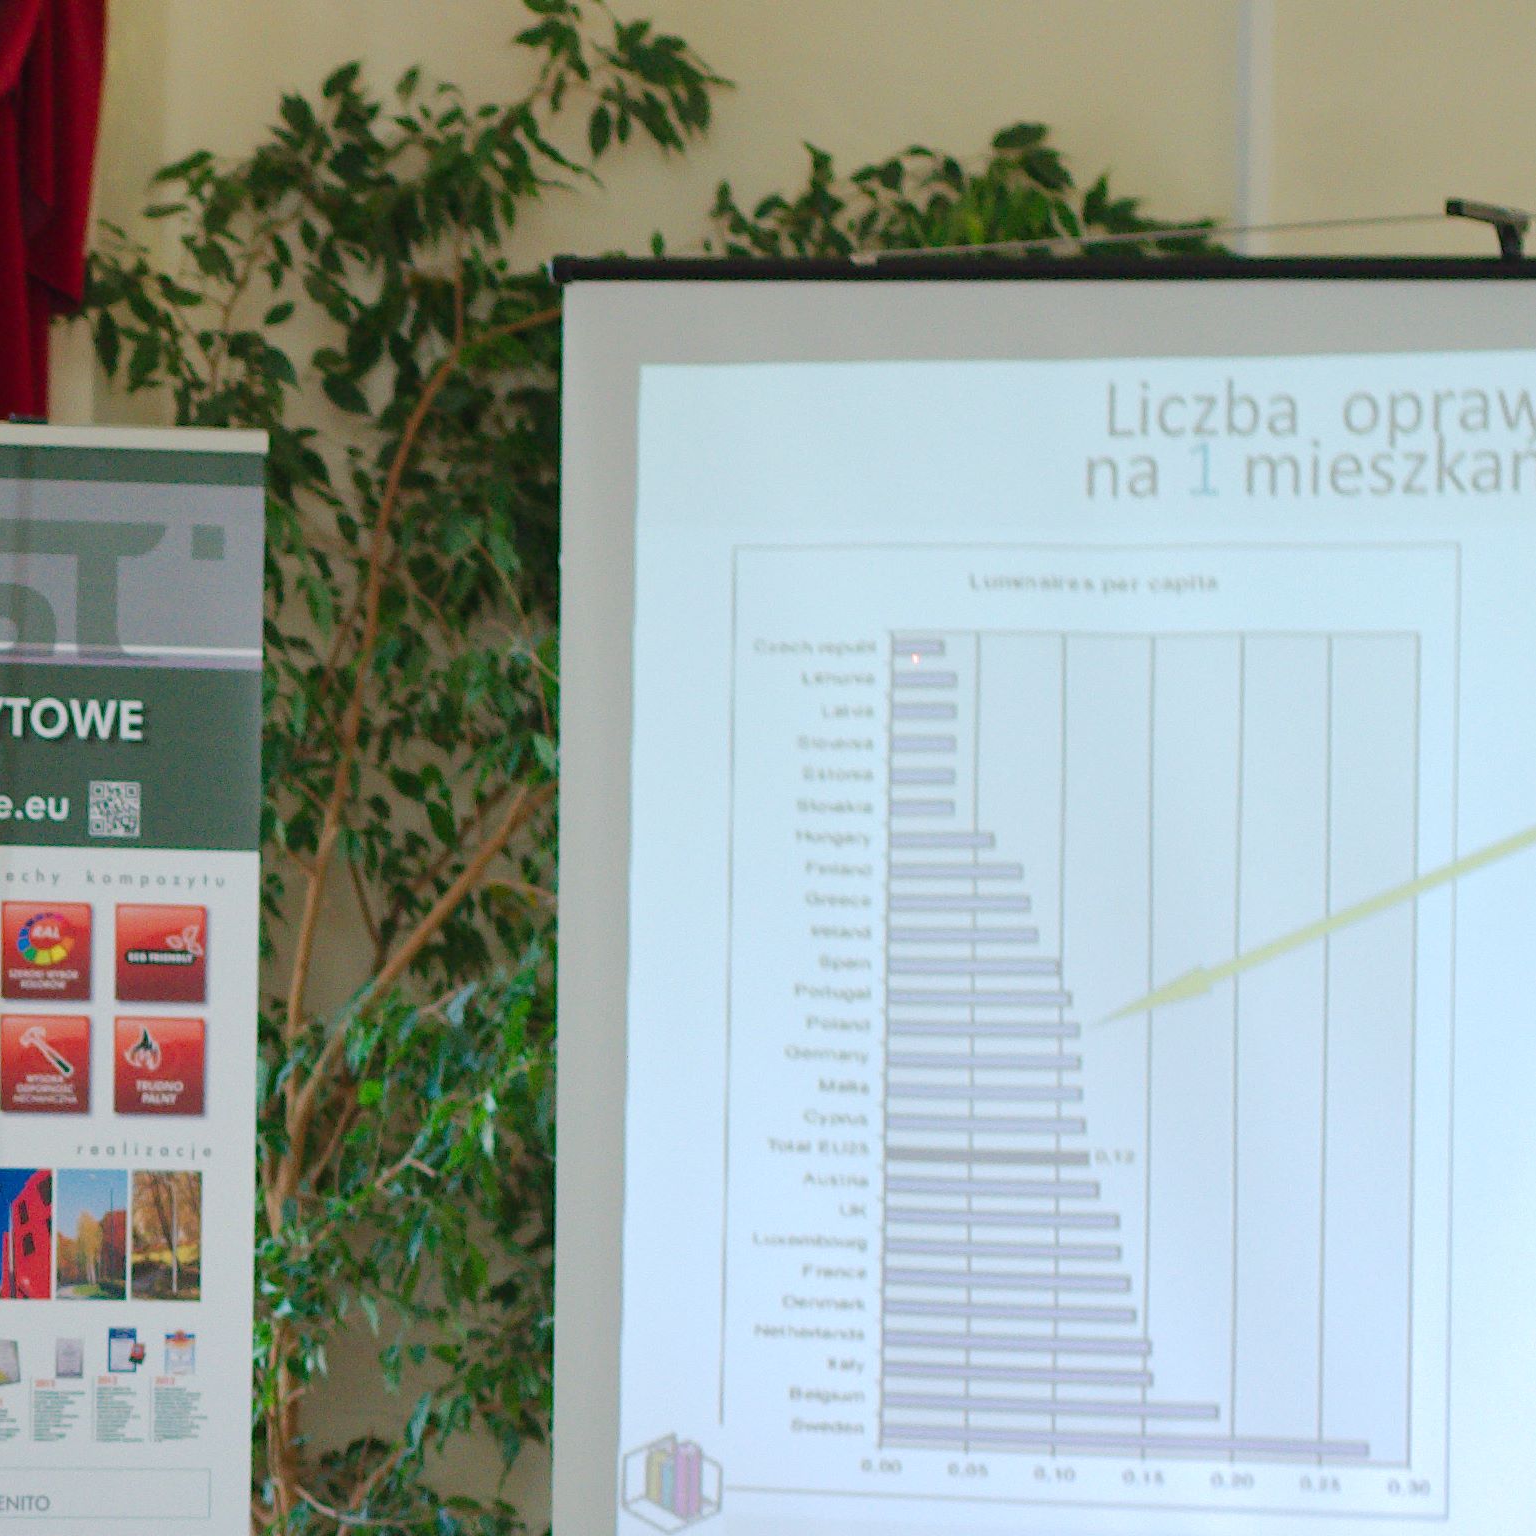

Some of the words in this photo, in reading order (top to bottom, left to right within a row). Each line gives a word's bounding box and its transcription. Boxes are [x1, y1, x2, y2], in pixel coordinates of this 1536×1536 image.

[1106, 377, 1300, 439] Liczba
[1085, 454, 1160, 499] na
[1189, 442, 1220, 497] 1
[85, 870, 227, 889] kompozytu
[78, 1143, 214, 1160] realizacje
